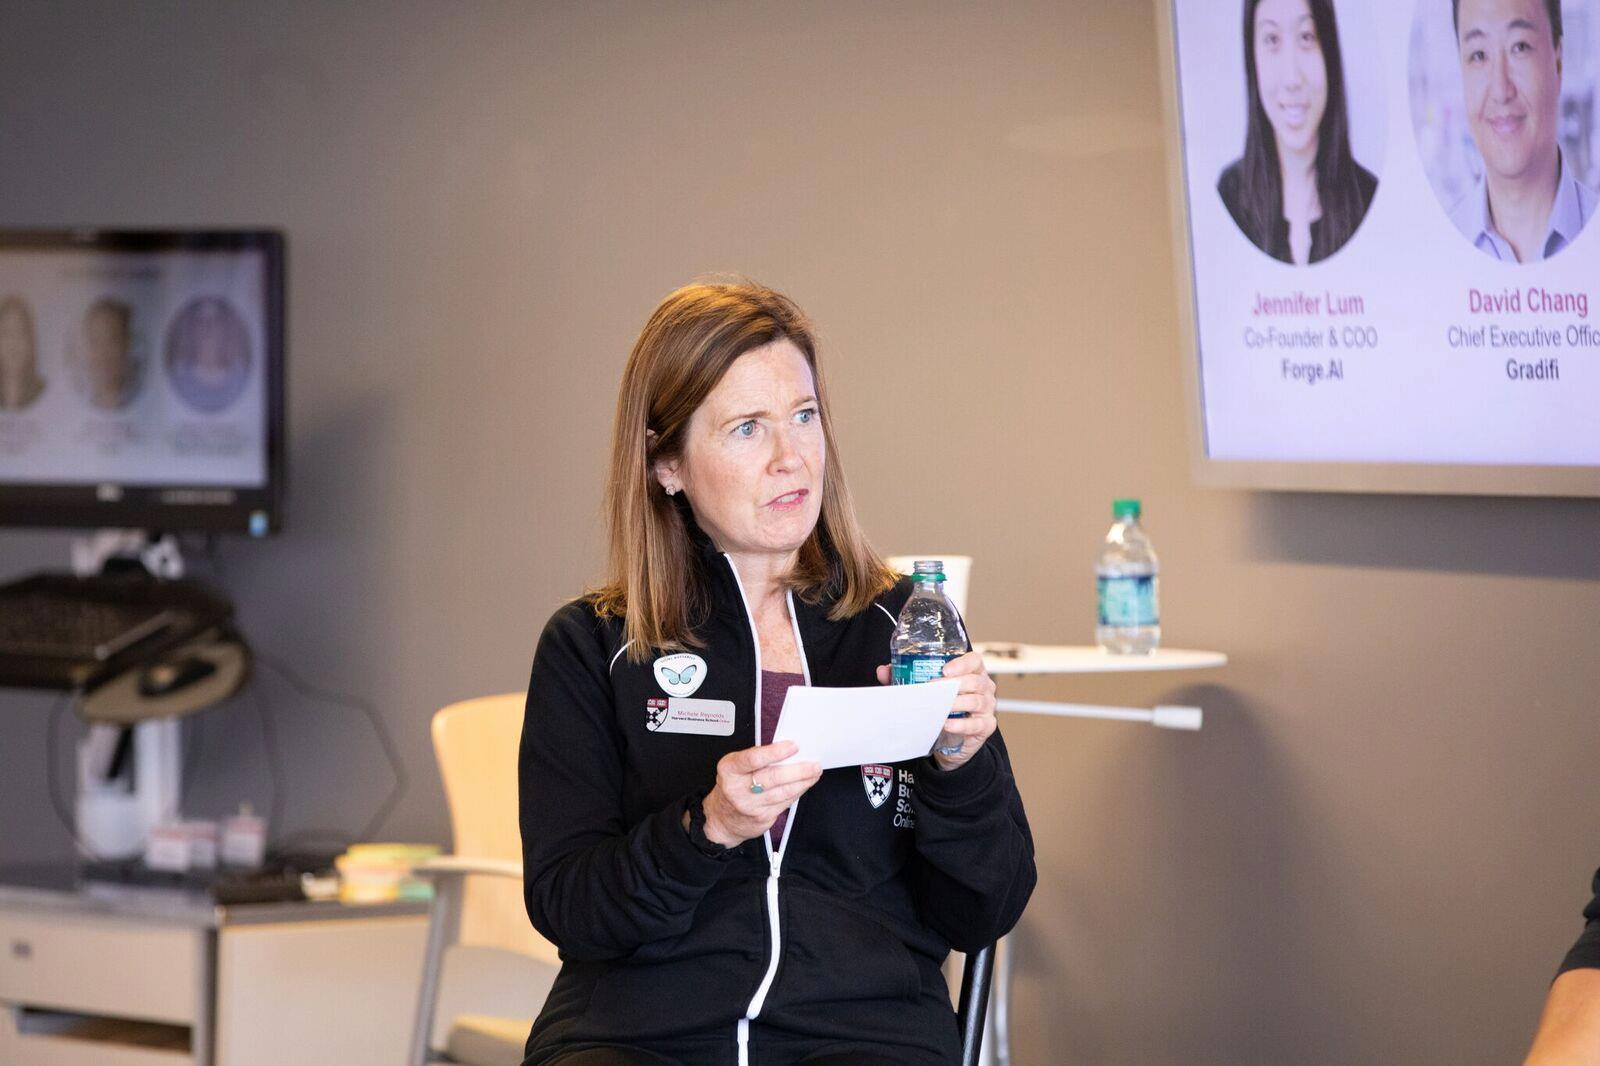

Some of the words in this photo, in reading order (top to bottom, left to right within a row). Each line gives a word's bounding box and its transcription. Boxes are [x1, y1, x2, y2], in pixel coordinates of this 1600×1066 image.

[1254, 291, 1320, 316] Jennifer
[1326, 291, 1365, 315] Lum
[1469, 288, 1521, 313] David
[1527, 287, 1588, 318] Chang
[1244, 326, 1323, 348] Co-Founder
[1329, 326, 1339, 348] &
[1343, 326, 1378, 348] COO
[1448, 325, 1485, 347] Chief
[1490, 325, 1561, 347] Executive
[1282, 358, 1344, 385] Forge.AI
[1506, 358, 1559, 380] Gradifi
